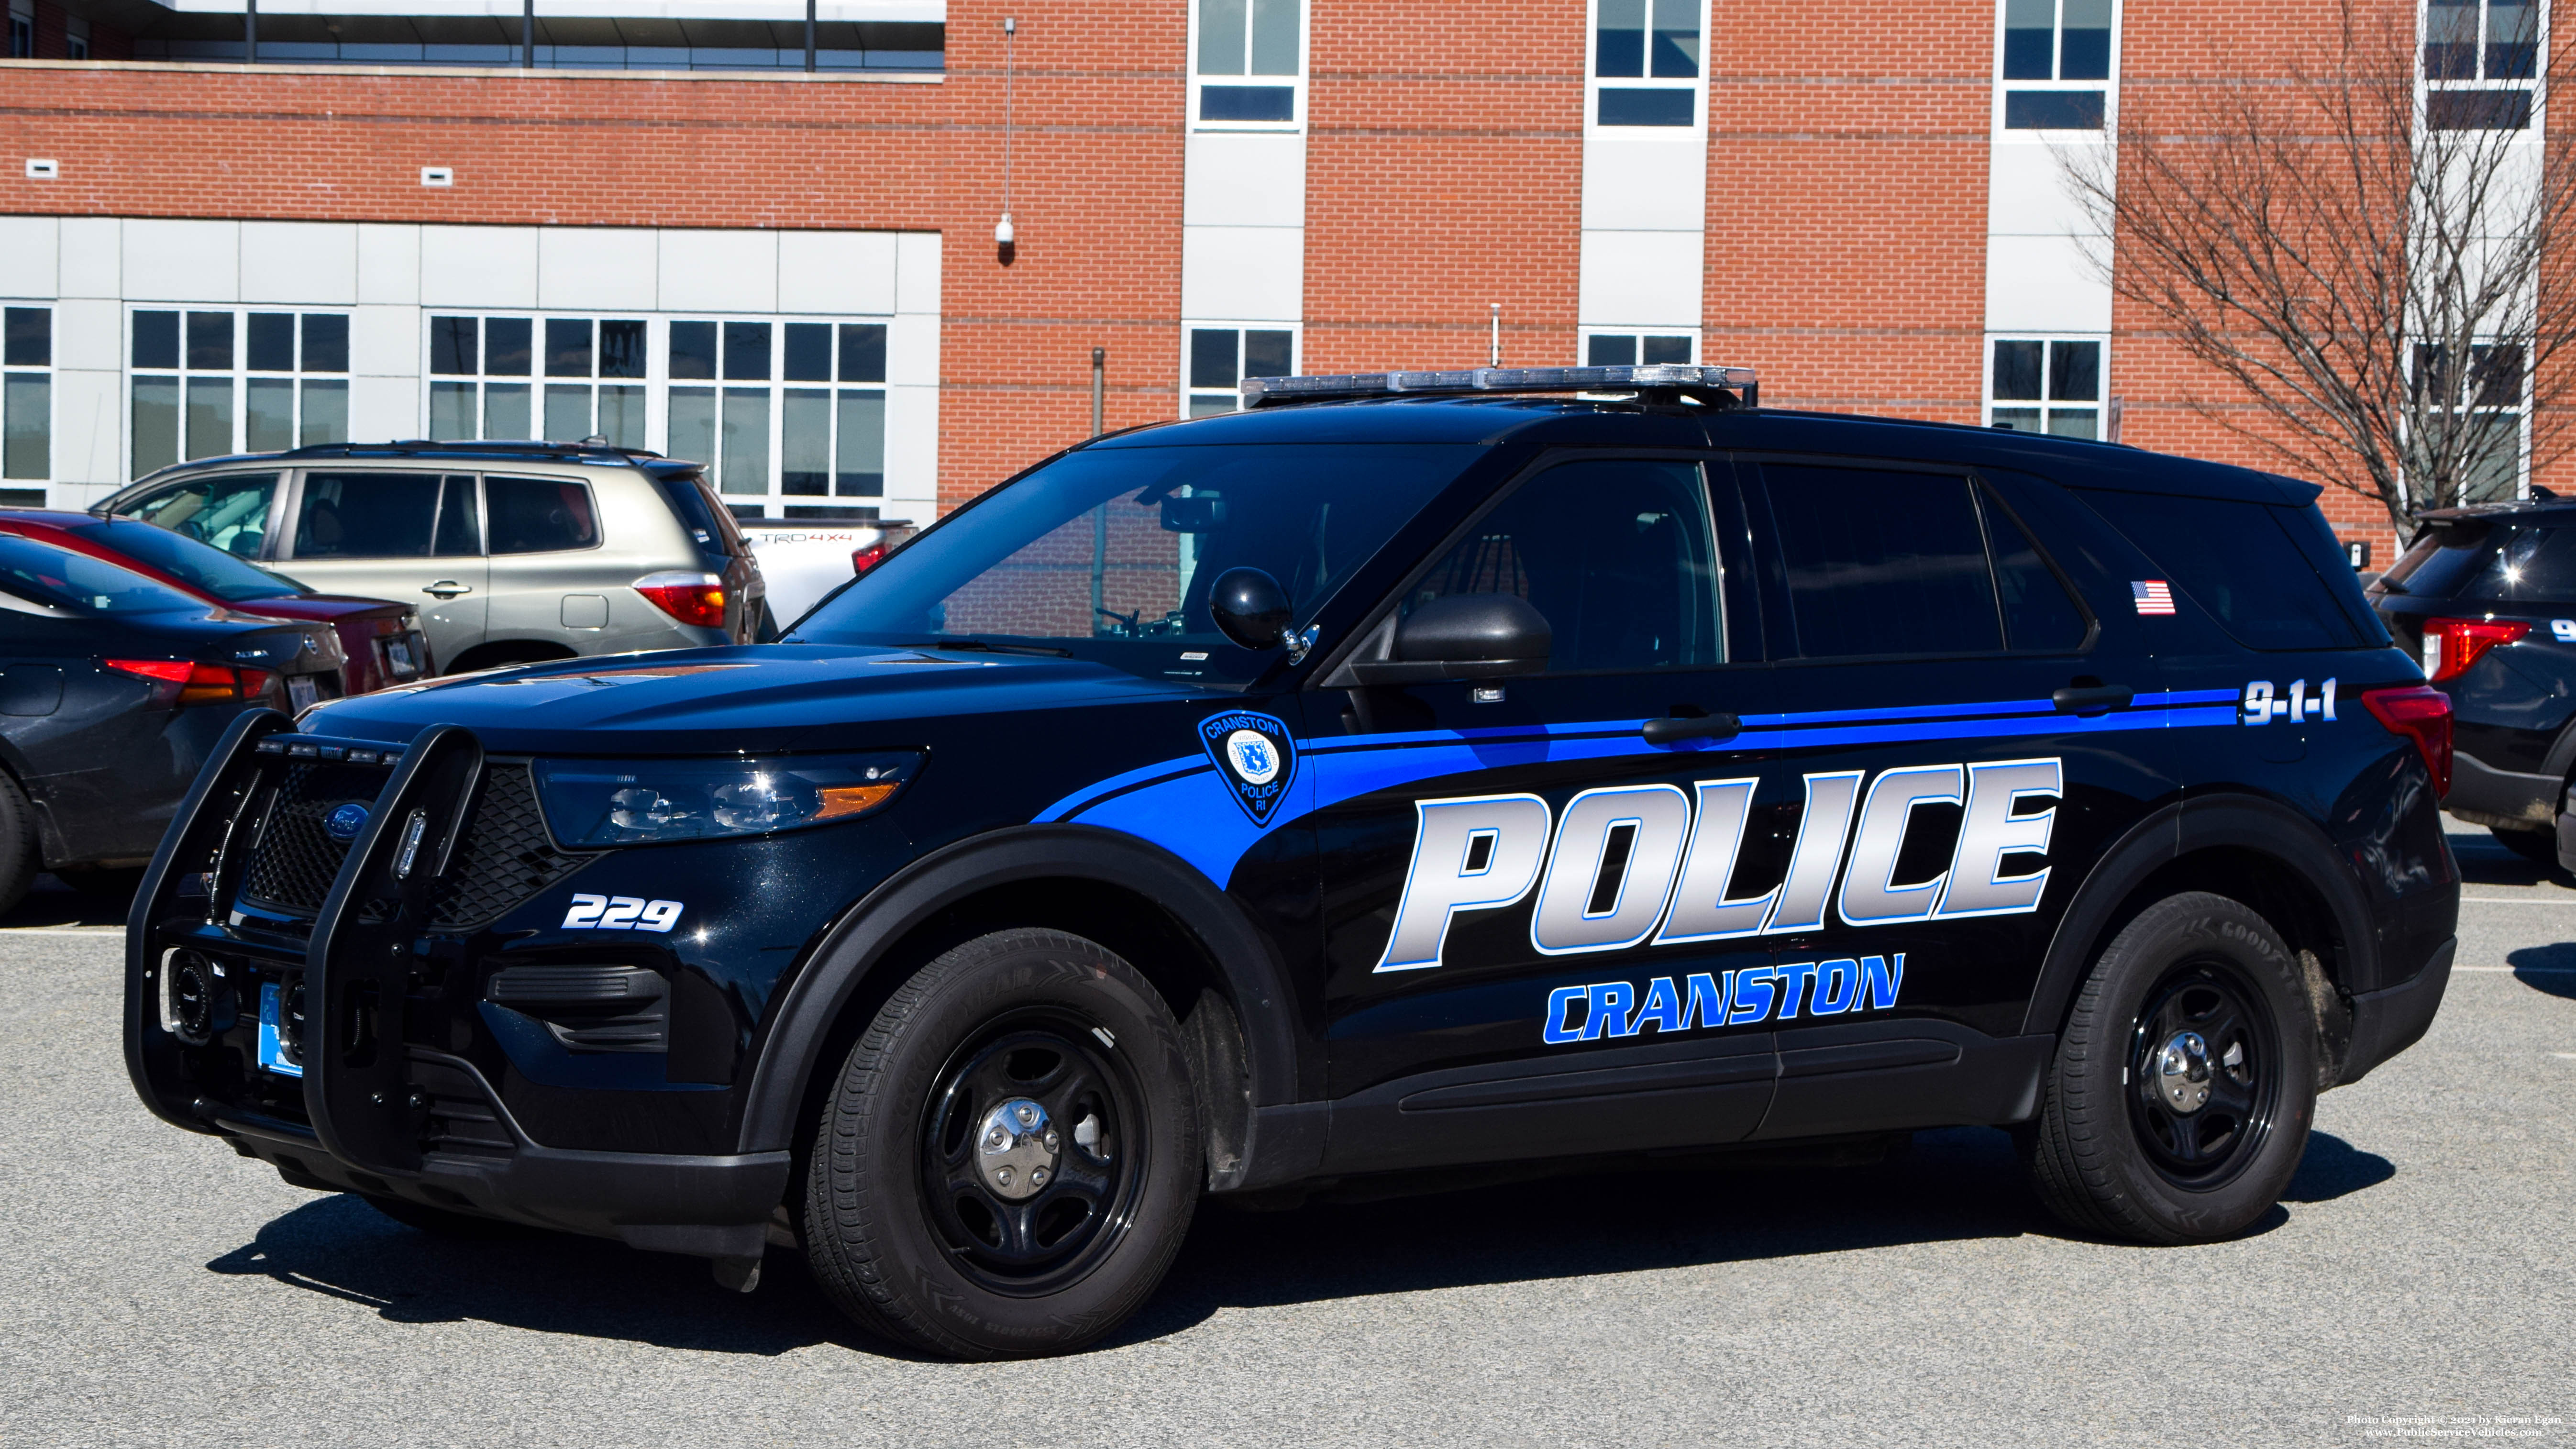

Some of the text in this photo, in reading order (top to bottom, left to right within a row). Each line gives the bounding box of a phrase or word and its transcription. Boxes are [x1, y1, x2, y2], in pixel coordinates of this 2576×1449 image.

[760, 534, 806, 543] TRD
[2244, 677, 2337, 726] 9-1-1
[1206, 716, 1279, 739] CRANSTON
[1241, 780, 1279, 798] POLICE
[1256, 800, 1266, 810] RI
[1372, 757, 2063, 973] POLICE
[561, 893, 684, 932] 229
[2221, 920, 2309, 1026] GOODYE
[1543, 952, 1906, 1045] CRANSTON
